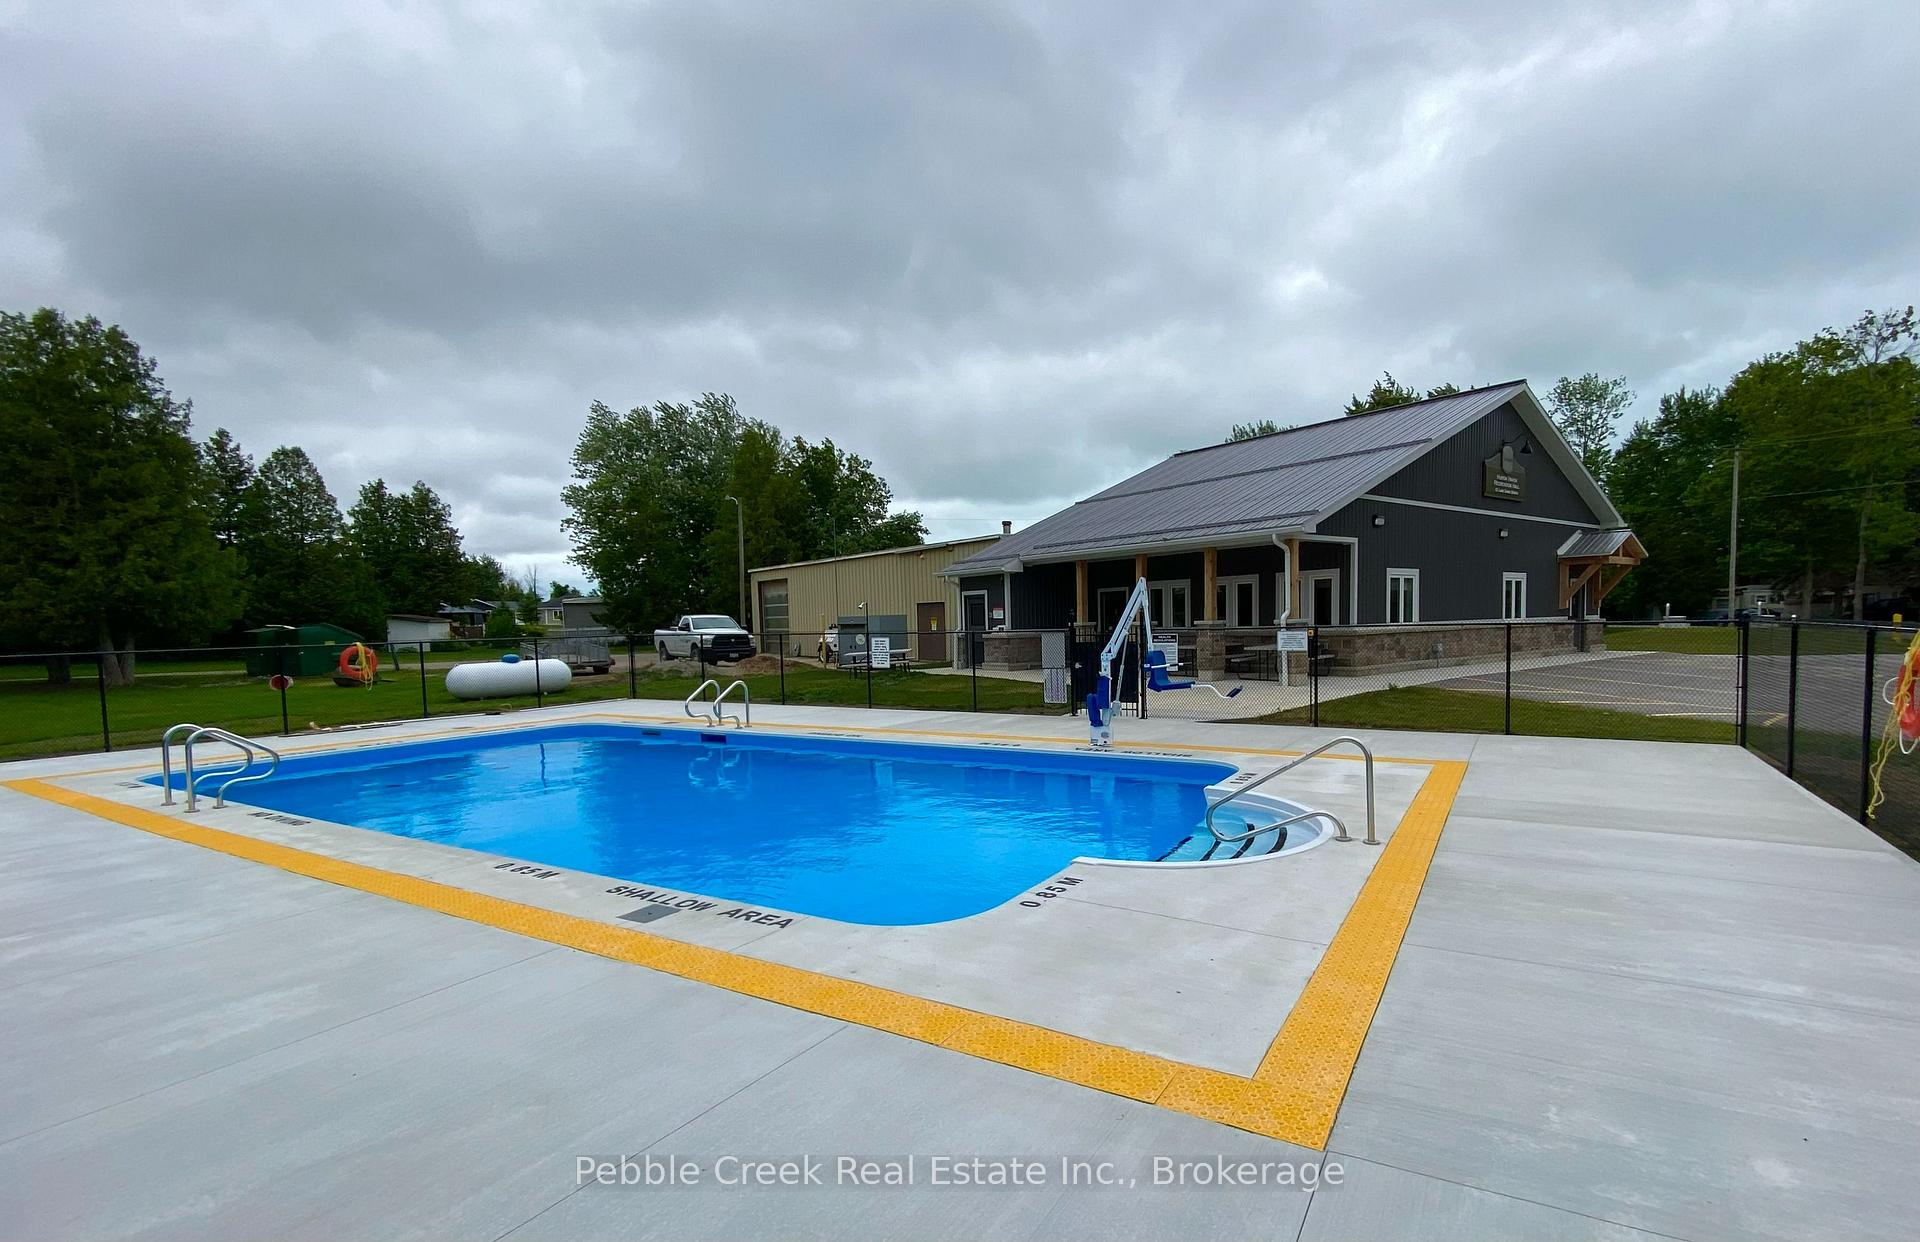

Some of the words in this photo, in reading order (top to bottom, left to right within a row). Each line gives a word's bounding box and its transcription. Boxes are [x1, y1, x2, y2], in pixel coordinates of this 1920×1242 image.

[606, 885, 717, 912] SHALLOW
[717, 907, 795, 929] AREA
[1019, 877, 1084, 908] 0.85M
